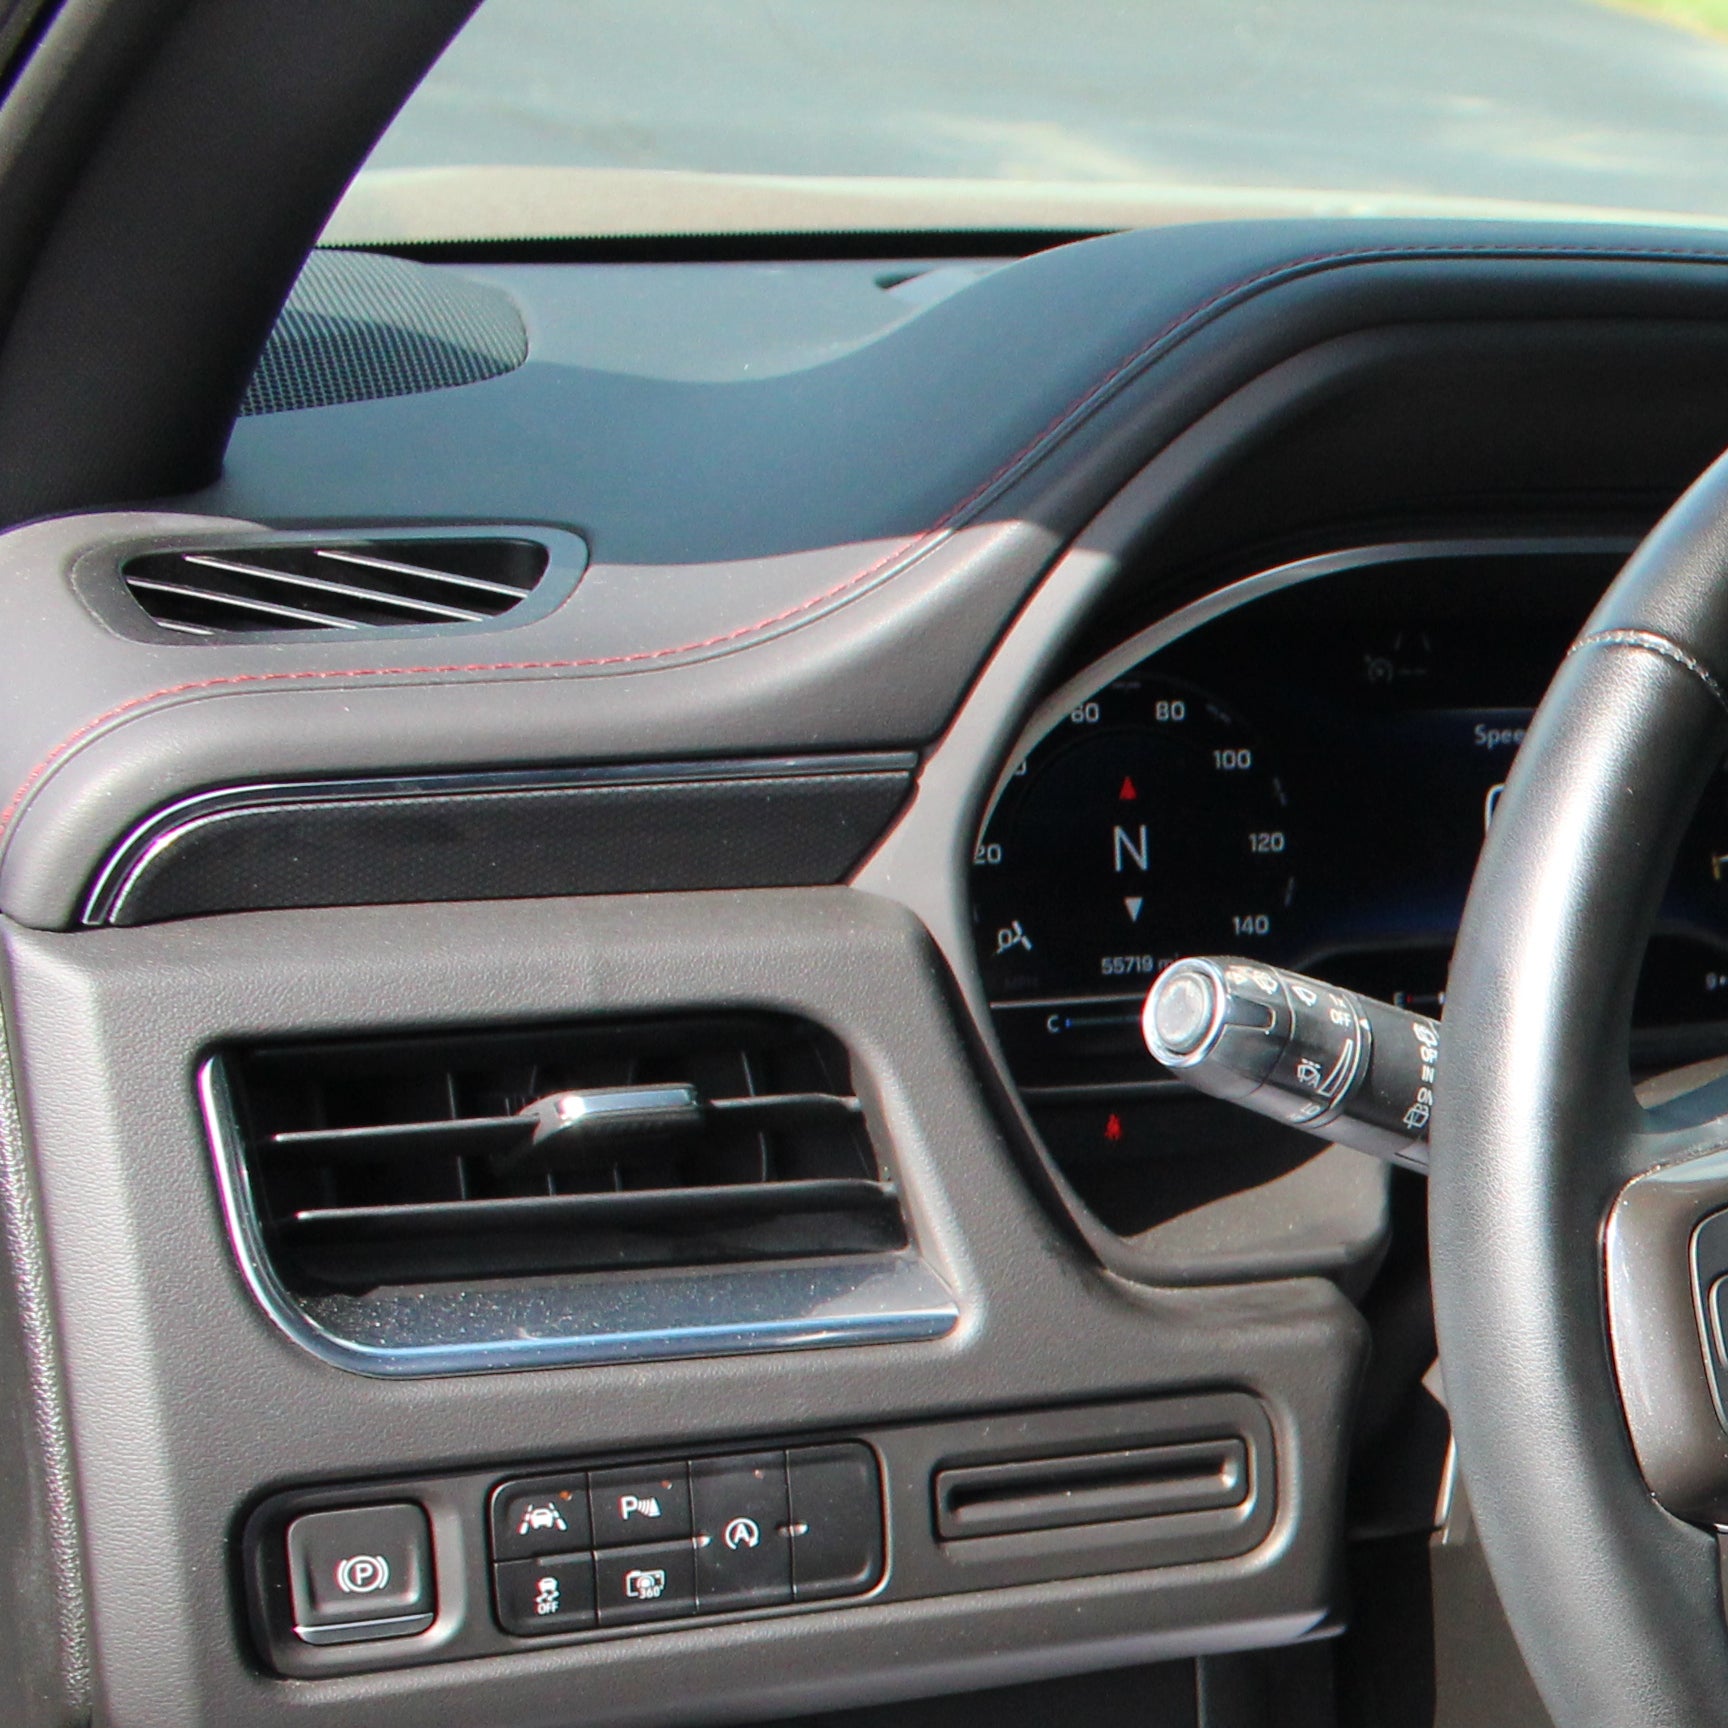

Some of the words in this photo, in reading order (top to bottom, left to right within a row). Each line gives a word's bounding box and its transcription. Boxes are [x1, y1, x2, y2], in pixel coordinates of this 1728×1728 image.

[1071, 702, 1099, 722] 60
[1155, 702, 1185, 721] 80
[1474, 723, 1527, 749] Spee
[1212, 750, 1251, 769] 100
[1113, 823, 1148, 872] N
[1248, 832, 1285, 852] 120
[973, 845, 1001, 864] 20
[1232, 916, 1269, 936] 140
[1102, 957, 1153, 974] 55719
[1047, 1014, 1060, 1031] C
[1330, 1009, 1351, 1026] OFF
[537, 1602, 559, 1615] OFF
